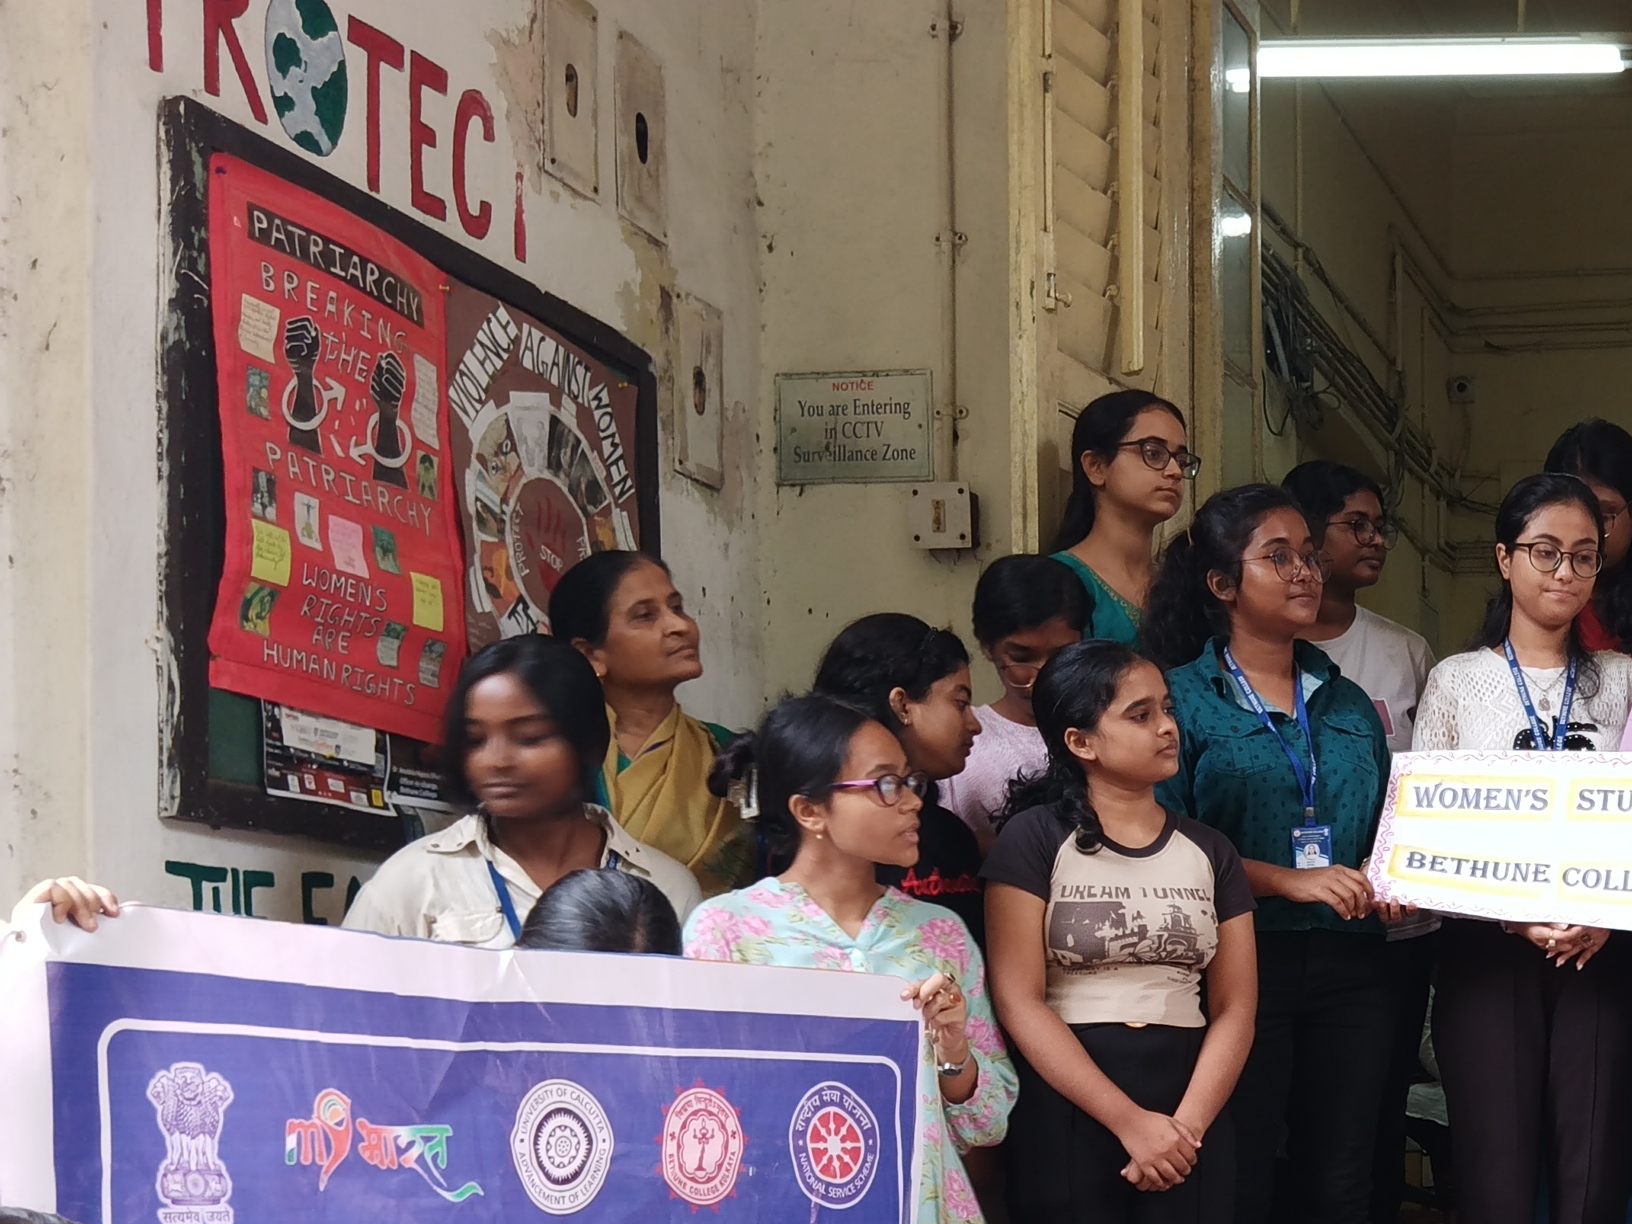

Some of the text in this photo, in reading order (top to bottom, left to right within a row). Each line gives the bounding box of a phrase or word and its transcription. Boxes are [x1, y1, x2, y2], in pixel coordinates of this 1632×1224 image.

[253, 210, 419, 321] PATRIARCHY
[261, 261, 409, 353] BREAKING
[322, 331, 371, 383] THE
[450, 313, 520, 423] VIOLENCE
[521, 326, 591, 406] AGAINST
[591, 383, 636, 500] WOMEN
[798, 397, 911, 420] You are Entering
[832, 381, 874, 392] NOTICE
[793, 443, 916, 464] Surveillance Zone
[825, 421, 884, 440] in CCTV
[266, 441, 432, 537] PATRIARCHY
[511, 502, 530, 577] PROTECT
[301, 595, 382, 637] RIGHTS
[313, 626, 351, 654] ARE
[263, 639, 336, 681] HUMAN
[341, 664, 416, 706] RIGHTS
[1413, 782, 1549, 812] WOMEN'S
[1406, 850, 1551, 884] BETHUNE
[520, 1087, 605, 1134] UNIVERSITY OF CALCUTTA
[518, 1148, 606, 1205] ADVANCEMENT OF LEARNING
[668, 1151, 737, 1197] BETHUNE COLLEGE KOLKATA
[799, 1153, 875, 1198] NATIONAL SERVICE SCHEME
